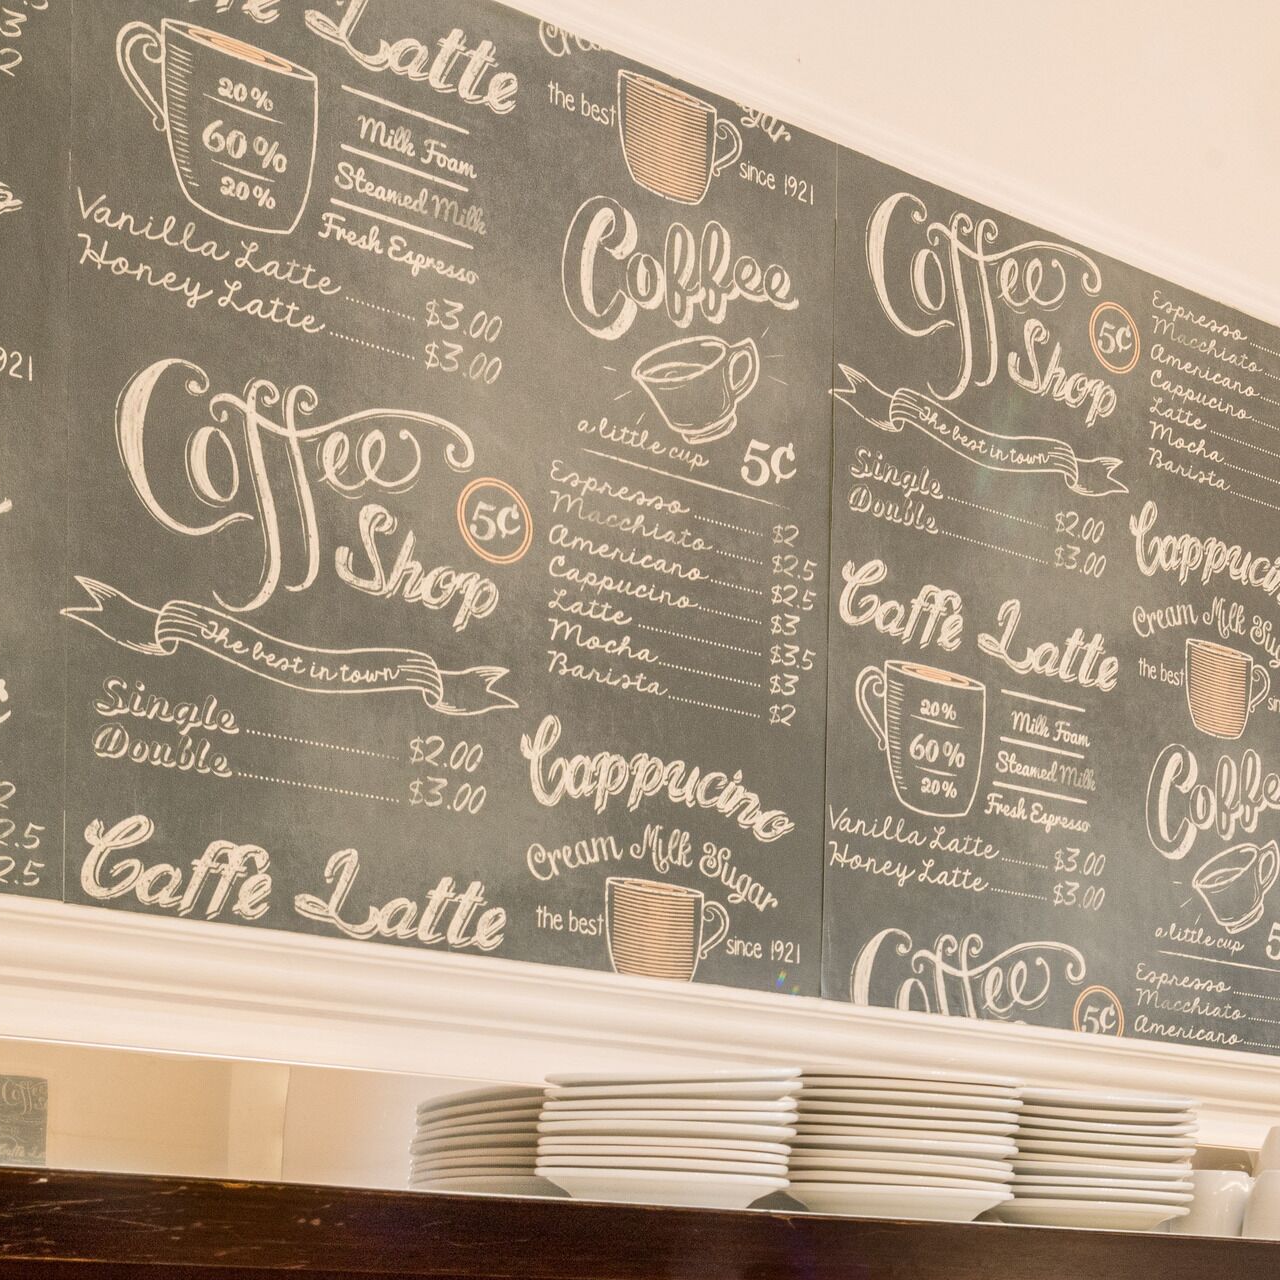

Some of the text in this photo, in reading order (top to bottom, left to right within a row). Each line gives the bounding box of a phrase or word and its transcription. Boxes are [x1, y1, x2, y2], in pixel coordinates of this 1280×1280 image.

[216, 76, 274, 112] 20%
[548, 81, 616, 128] the best
[201, 120, 288, 174] 60%
[358, 114, 478, 181] Milk Foam
[739, 160, 815, 206] since 1921
[218, 175, 277, 210] 20%
[334, 161, 488, 236] Steamed Milk
[76, 186, 504, 343] Vanilla Latte $3.00
[318, 212, 480, 287] Fresh Espresso
[562, 195, 799, 341] Coffee
[76, 232, 504, 385] Honey Latte $3.00
[865, 192, 1103, 402] Coffee
[1151, 289, 1247, 342] Espresso
[1007, 317, 1118, 429] Shop
[1097, 320, 1134, 356] 5¢
[1150, 343, 1262, 398] Americano
[1151, 315, 1264, 373] Macchiato
[114, 357, 476, 613] Coffee
[740, 438, 798, 487] 5¢
[848, 445, 1106, 545] Single $2.00
[468, 498, 524, 542] 5¢
[549, 459, 800, 548] Espresso $2
[549, 490, 818, 583] Macchiato $2.5
[334, 503, 502, 634] Shop
[548, 523, 818, 612] Americano $2.5
[548, 554, 801, 636] Cappucino $3
[199, 618, 401, 685] The best in town
[547, 587, 817, 671] Latte $3.5
[547, 617, 801, 697] Mocha $3
[94, 674, 484, 773] Single $2.00
[546, 649, 797, 728] Barista $2
[93, 722, 488, 815] Double $3.00
[520, 714, 796, 843] Cappucino
[526, 833, 624, 881] Cream
[629, 823, 694, 875] Milk
[828, 803, 1107, 877] Vanilla Latte $3.00
[294, 848, 509, 951] Latte
